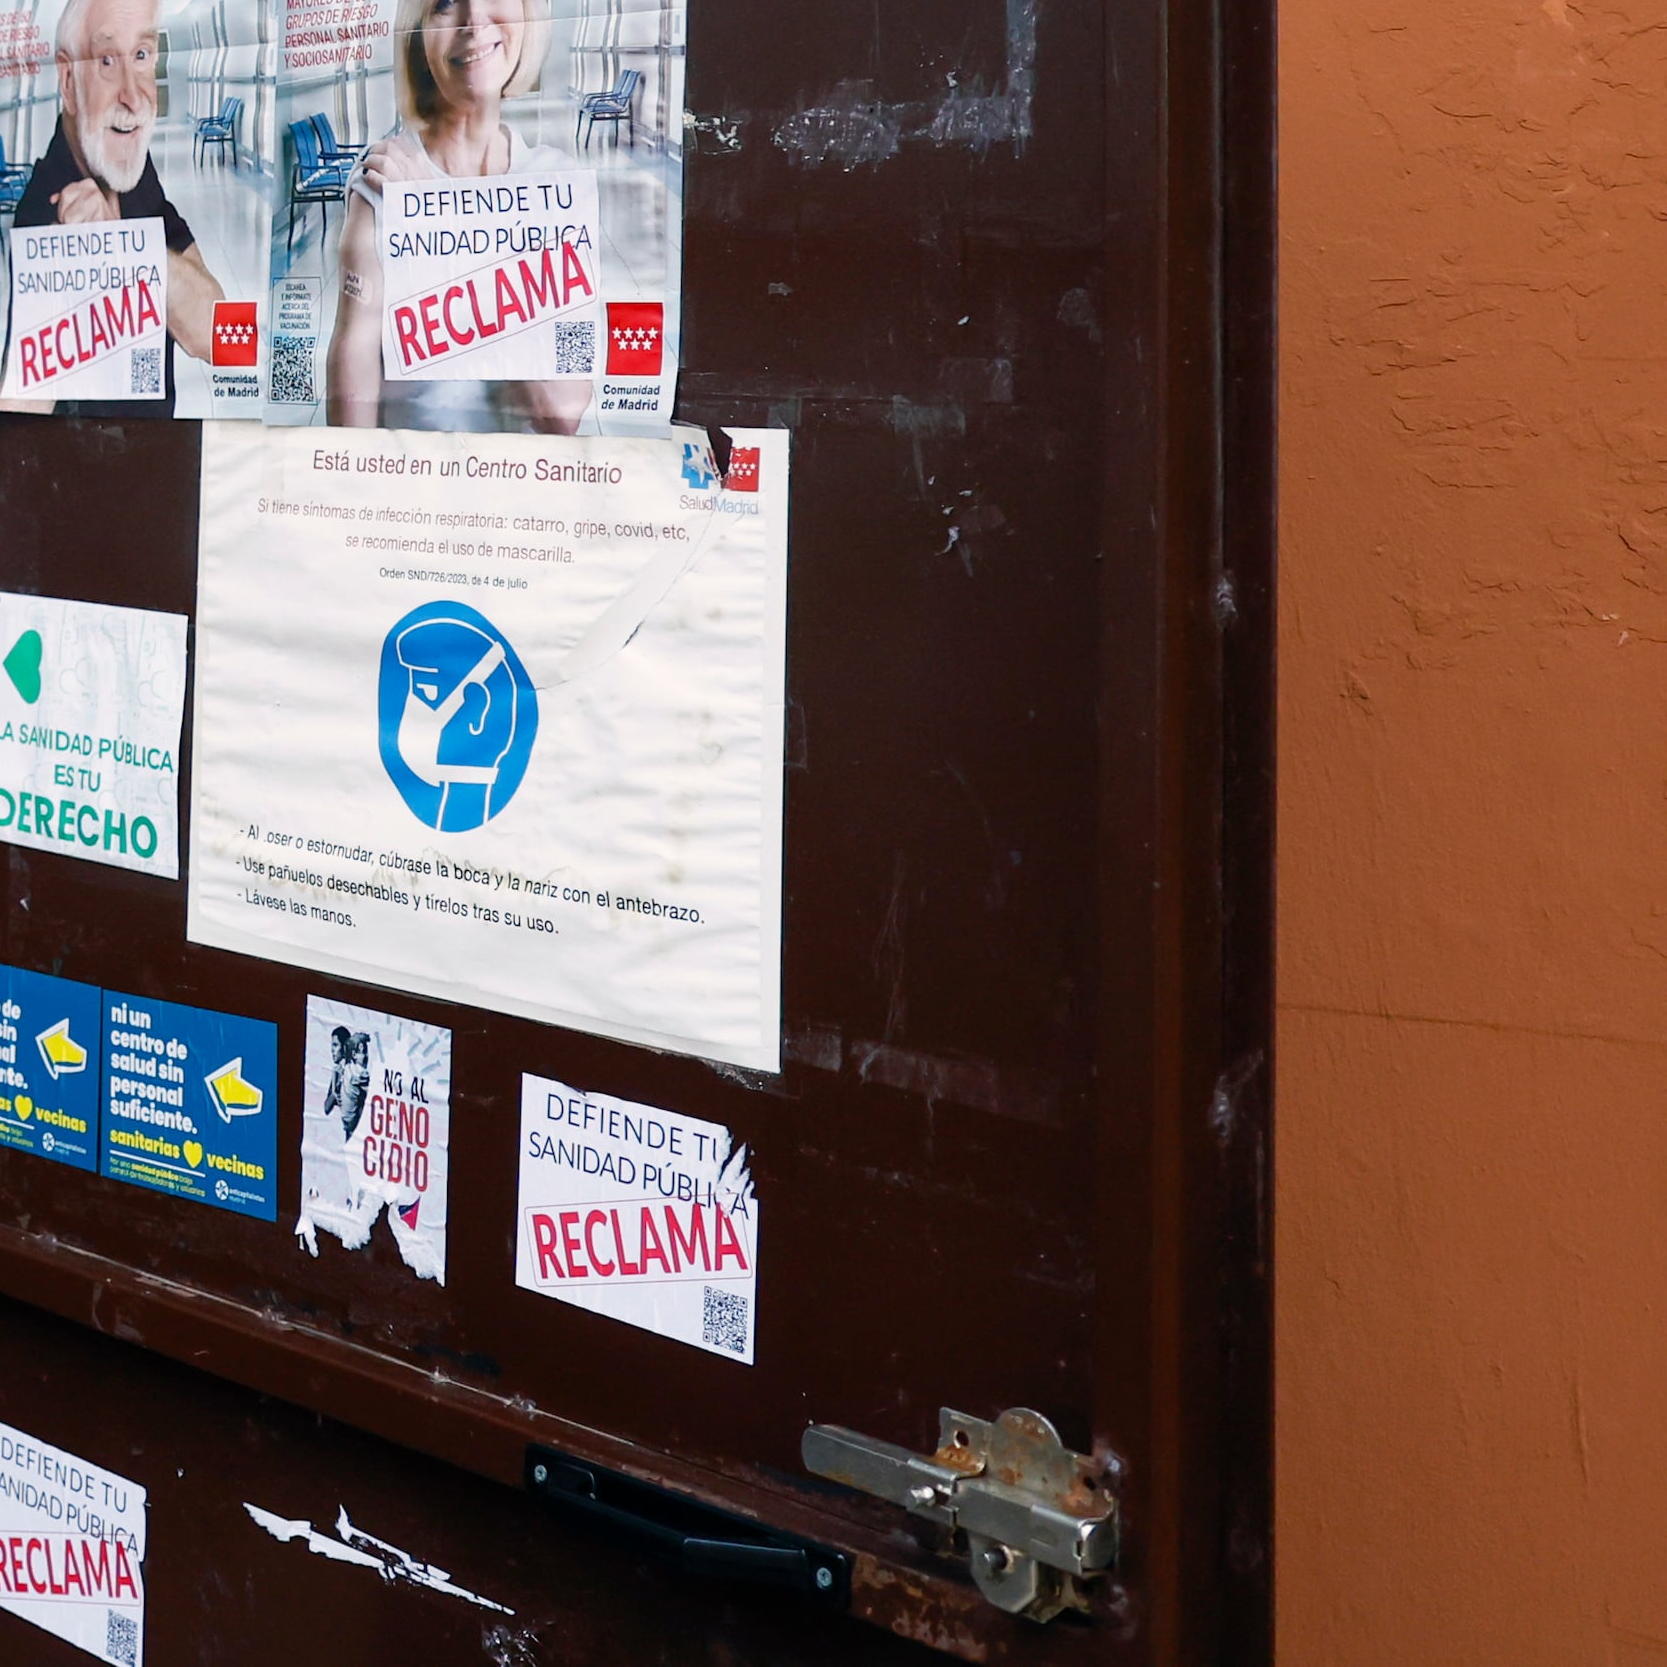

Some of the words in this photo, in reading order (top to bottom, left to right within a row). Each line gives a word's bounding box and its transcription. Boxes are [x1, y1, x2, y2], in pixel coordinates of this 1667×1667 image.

[285, 30, 337, 49] PERSONAL
[337, 20, 389, 42] SANITARIO
[403, 186, 530, 218] DEFIENDE
[537, 183, 574, 211] TU
[26, 232, 114, 260] DEFIENDE
[116, 229, 146, 253] TU
[389, 229, 490, 258] SANIDAD
[495, 220, 593, 254] PÚBLICA
[18, 269, 85, 294] SANIDAD
[89, 261, 162, 290] PÚBLICA
[393, 239, 594, 367] RECLAMA
[20, 279, 162, 388] RECLAMA
[601, 399, 616, 411] de
[617, 398, 660, 412] Madrid
[602, 384, 661, 397] Comunidad
[313, 449, 351, 472] Está
[356, 453, 407, 475] usted
[410, 460, 432, 476] en
[439, 461, 461, 477] un
[466, 455, 528, 480] Centro
[534, 457, 623, 485] Sanitario
[257, 497, 269, 513] Si
[271, 499, 300, 515] tiene
[302, 501, 356, 521] síntomas
[358, 506, 374, 522] de
[375, 507, 432, 525] infección
[435, 512, 509, 530] respiratoria:
[513, 515, 570, 535] catarro,
[573, 520, 612, 541] gripe,
[614, 521, 659, 541] covid,
[662, 524, 691, 543] etc,
[679, 494, 760, 516] SaludMadrid
[345, 535, 360, 548] se
[361, 536, 435, 554] recomienda
[438, 539, 449, 555] el
[452, 542, 475, 557] uso
[477, 541, 493, 558] de
[497, 543, 576, 564] mascarilla.
[379, 567, 406, 580] Orden
[471, 574, 482, 586] de
[483, 575, 490, 587] 4
[492, 575, 505, 588] de
[507, 577, 528, 591] julio
[19, 723, 93, 756] SANIDAD
[98, 734, 174, 773] PÚBLICA
[54, 764, 75, 786] ES
[78, 767, 102, 793] TU
[247, 824, 259, 840] Al
[263, 830, 294, 849] oser
[295, 837, 304, 850] o
[307, 839, 375, 866] estornudar,
[379, 851, 432, 875] cúbrase
[436, 860, 449, 878] la
[454, 863, 490, 886] boca
[493, 874, 504, 891] y
[507, 872, 520, 891] la
[524, 879, 559, 899] nariz
[563, 886, 591, 905] con
[596, 890, 610, 908] el
[616, 896, 706, 925] antebrazo.
[243, 855, 265, 875] Use
[268, 864, 324, 887] pañuelos
[327, 874, 410, 906] desechables
[412, 894, 422, 911] y
[425, 893, 469, 918] tírelos
[472, 902, 500, 923] tras
[504, 912, 522, 928] su
[526, 916, 560, 935] uso.
[245, 886, 287, 912] Lávese
[290, 899, 308, 916] las
[310, 906, 358, 928] manos.
[2, 999, 22, 1020] de
[110, 1002, 129, 1024] ni
[128, 1009, 152, 1030] un
[110, 1029, 165, 1056] centro
[166, 1037, 188, 1061] de
[110, 1052, 157, 1078] salud
[158, 1059, 184, 1084] sin
[383, 1068, 403, 1096] NO
[410, 1076, 430, 1105] AL
[110, 1075, 184, 1107] personal
[35, 1106, 87, 1133] vecinas
[110, 1098, 198, 1135] suficiente.
[370, 1094, 430, 1149] GENO
[546, 1092, 684, 1156] DEFIENDE
[110, 1128, 181, 1160] sanitarias
[206, 1152, 265, 1181] vecinas
[363, 1135, 429, 1193] CIDIO
[528, 1130, 636, 1186] SANIDAD
[531, 1201, 750, 1279] RECLAMA
[0, 1436, 96, 1501] DEFIENDE
[101, 1480, 128, 1514] TU
[67, 1503, 140, 1556] PÚBLICA
